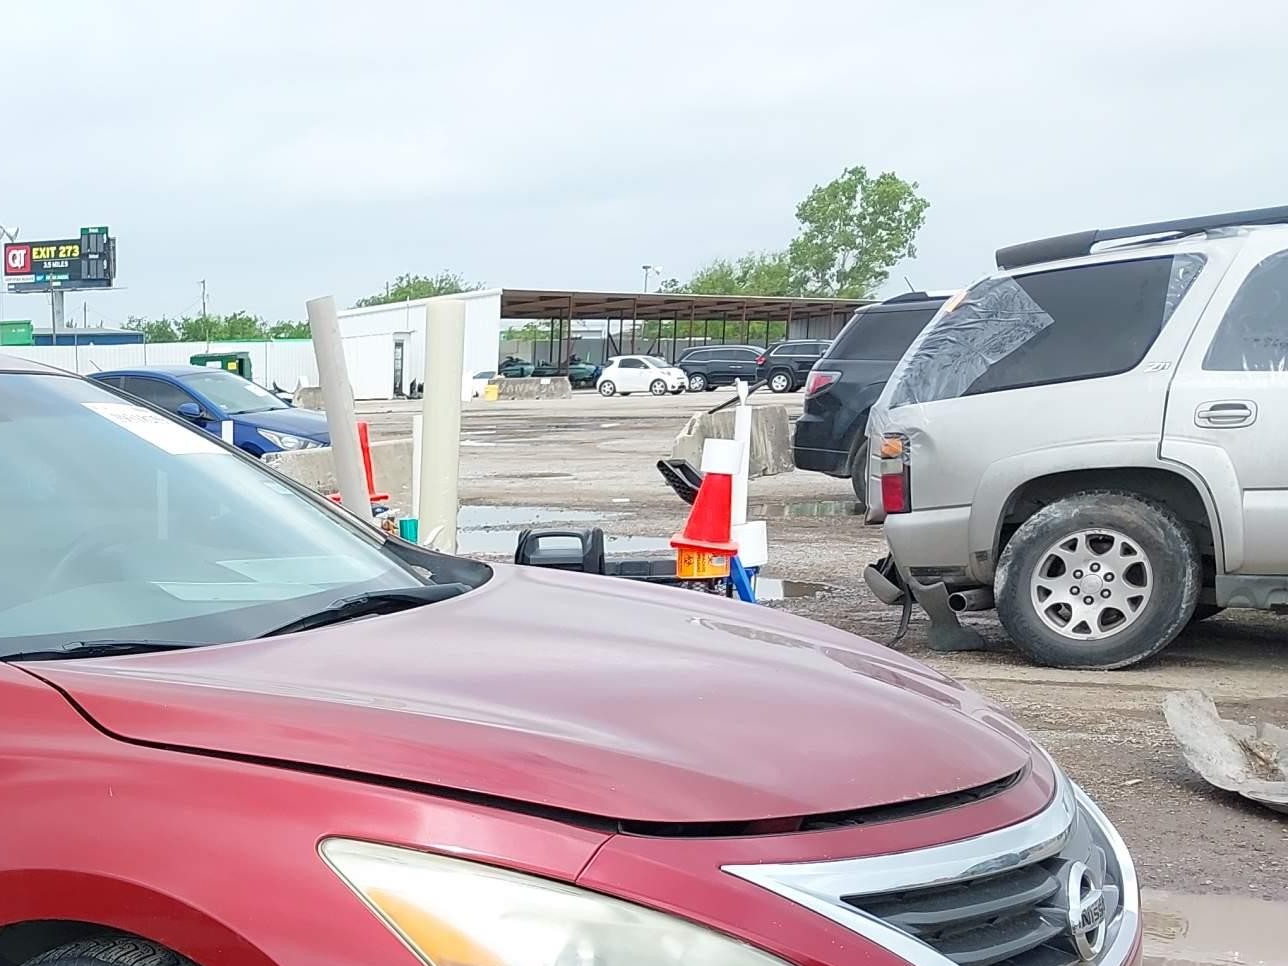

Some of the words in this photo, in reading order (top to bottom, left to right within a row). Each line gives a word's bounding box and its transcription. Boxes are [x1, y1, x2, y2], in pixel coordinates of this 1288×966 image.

[8, 248, 27, 270] QT
[32, 246, 56, 260] EXIT
[58, 244, 80, 258] 273
[52, 260, 69, 268] MILES
